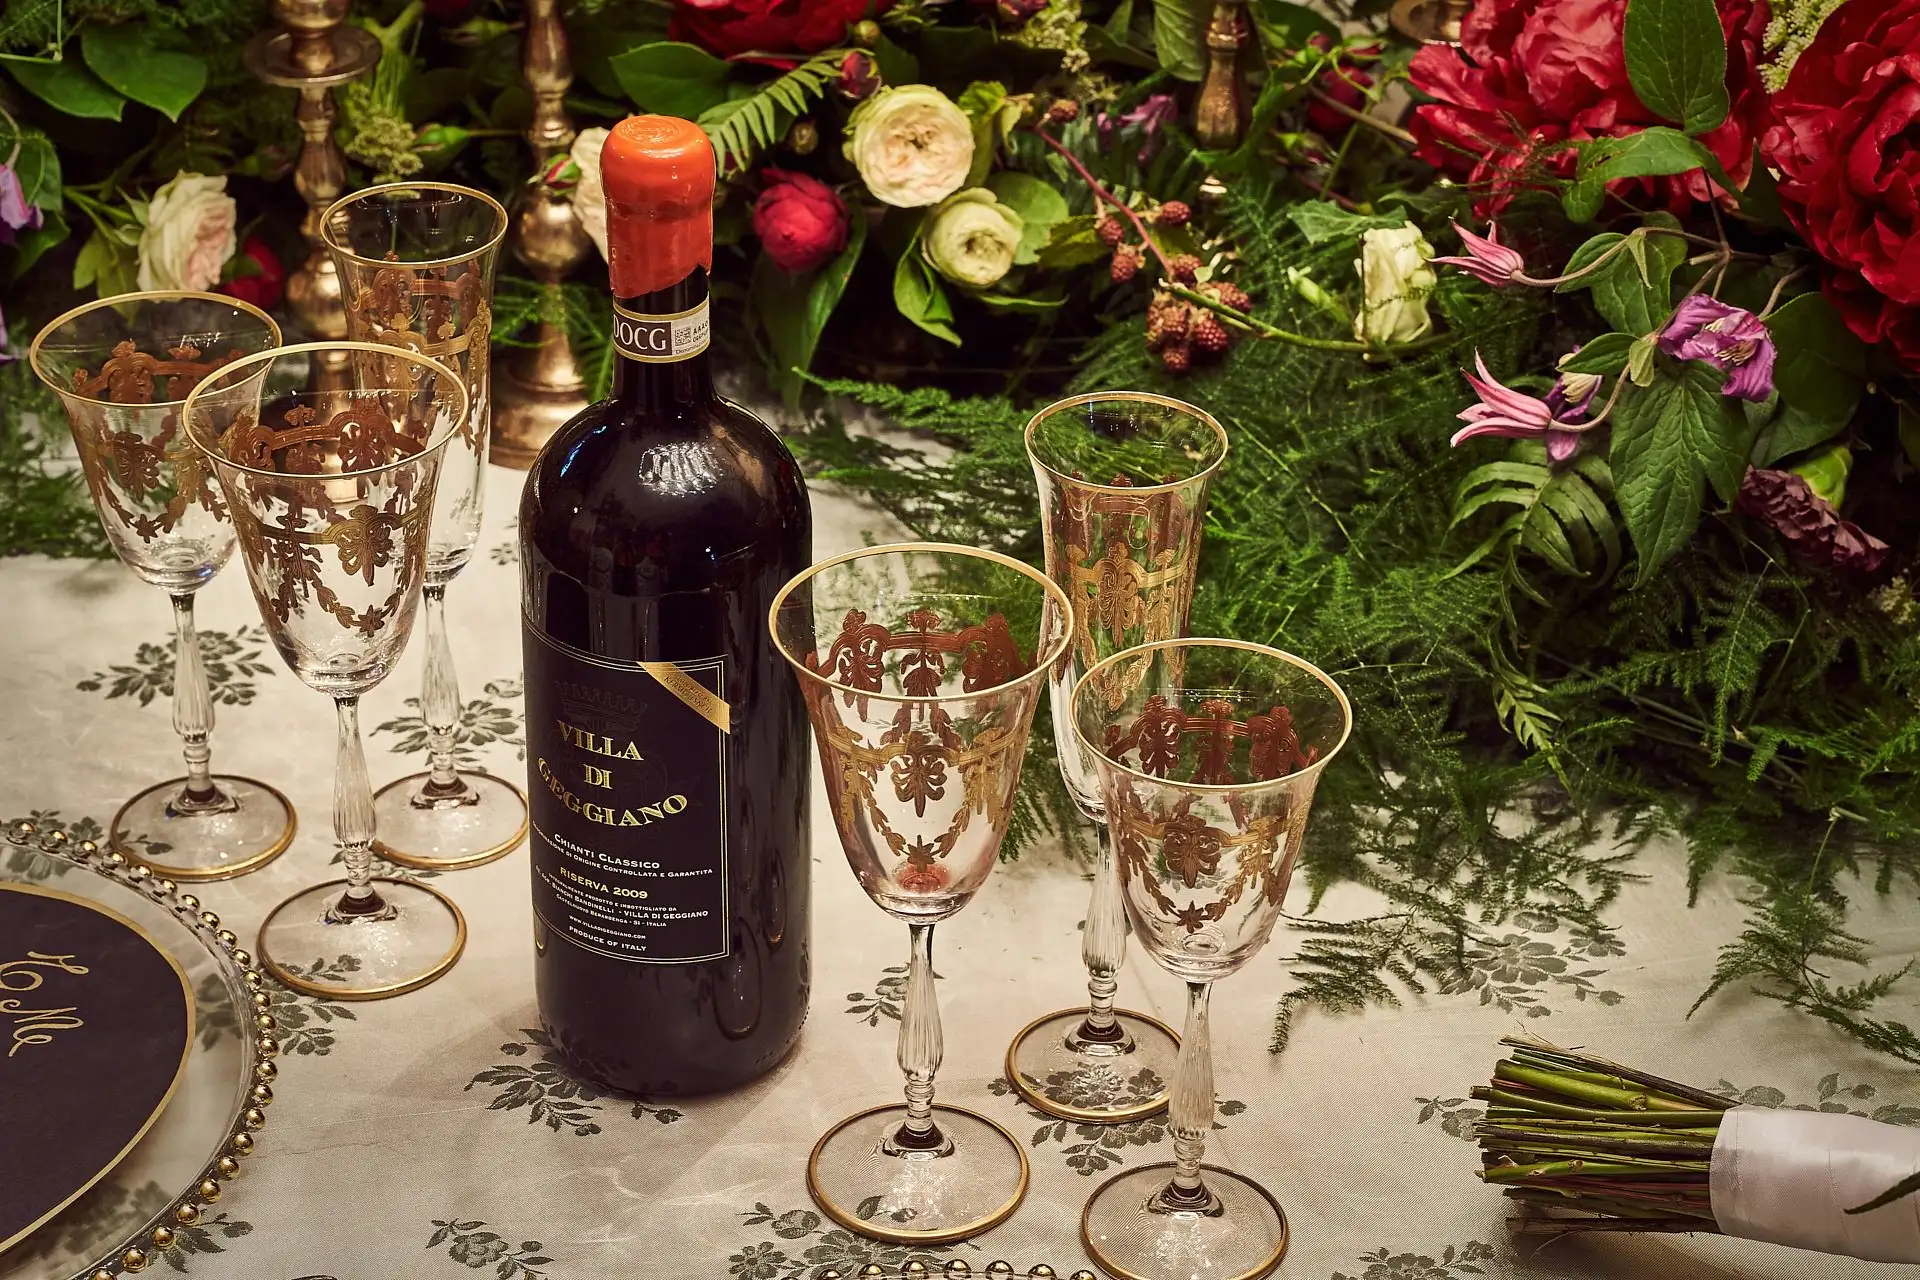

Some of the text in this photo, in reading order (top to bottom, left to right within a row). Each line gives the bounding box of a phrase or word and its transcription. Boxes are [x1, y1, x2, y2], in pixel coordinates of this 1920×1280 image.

[613, 314, 666, 351] DOCG
[557, 719, 644, 761] VILLA
[538, 757, 688, 827] GEGGIANO
[582, 763, 613, 790] DI
[560, 866, 648, 899] RISERVA 2009
[574, 895, 614, 913] BANDINELLI
[624, 910, 649, 919] VILLA
[662, 910, 708, 919] GEGGIANO
[569, 925, 605, 944] PRODUCE
[621, 943, 647, 952] ITALY
